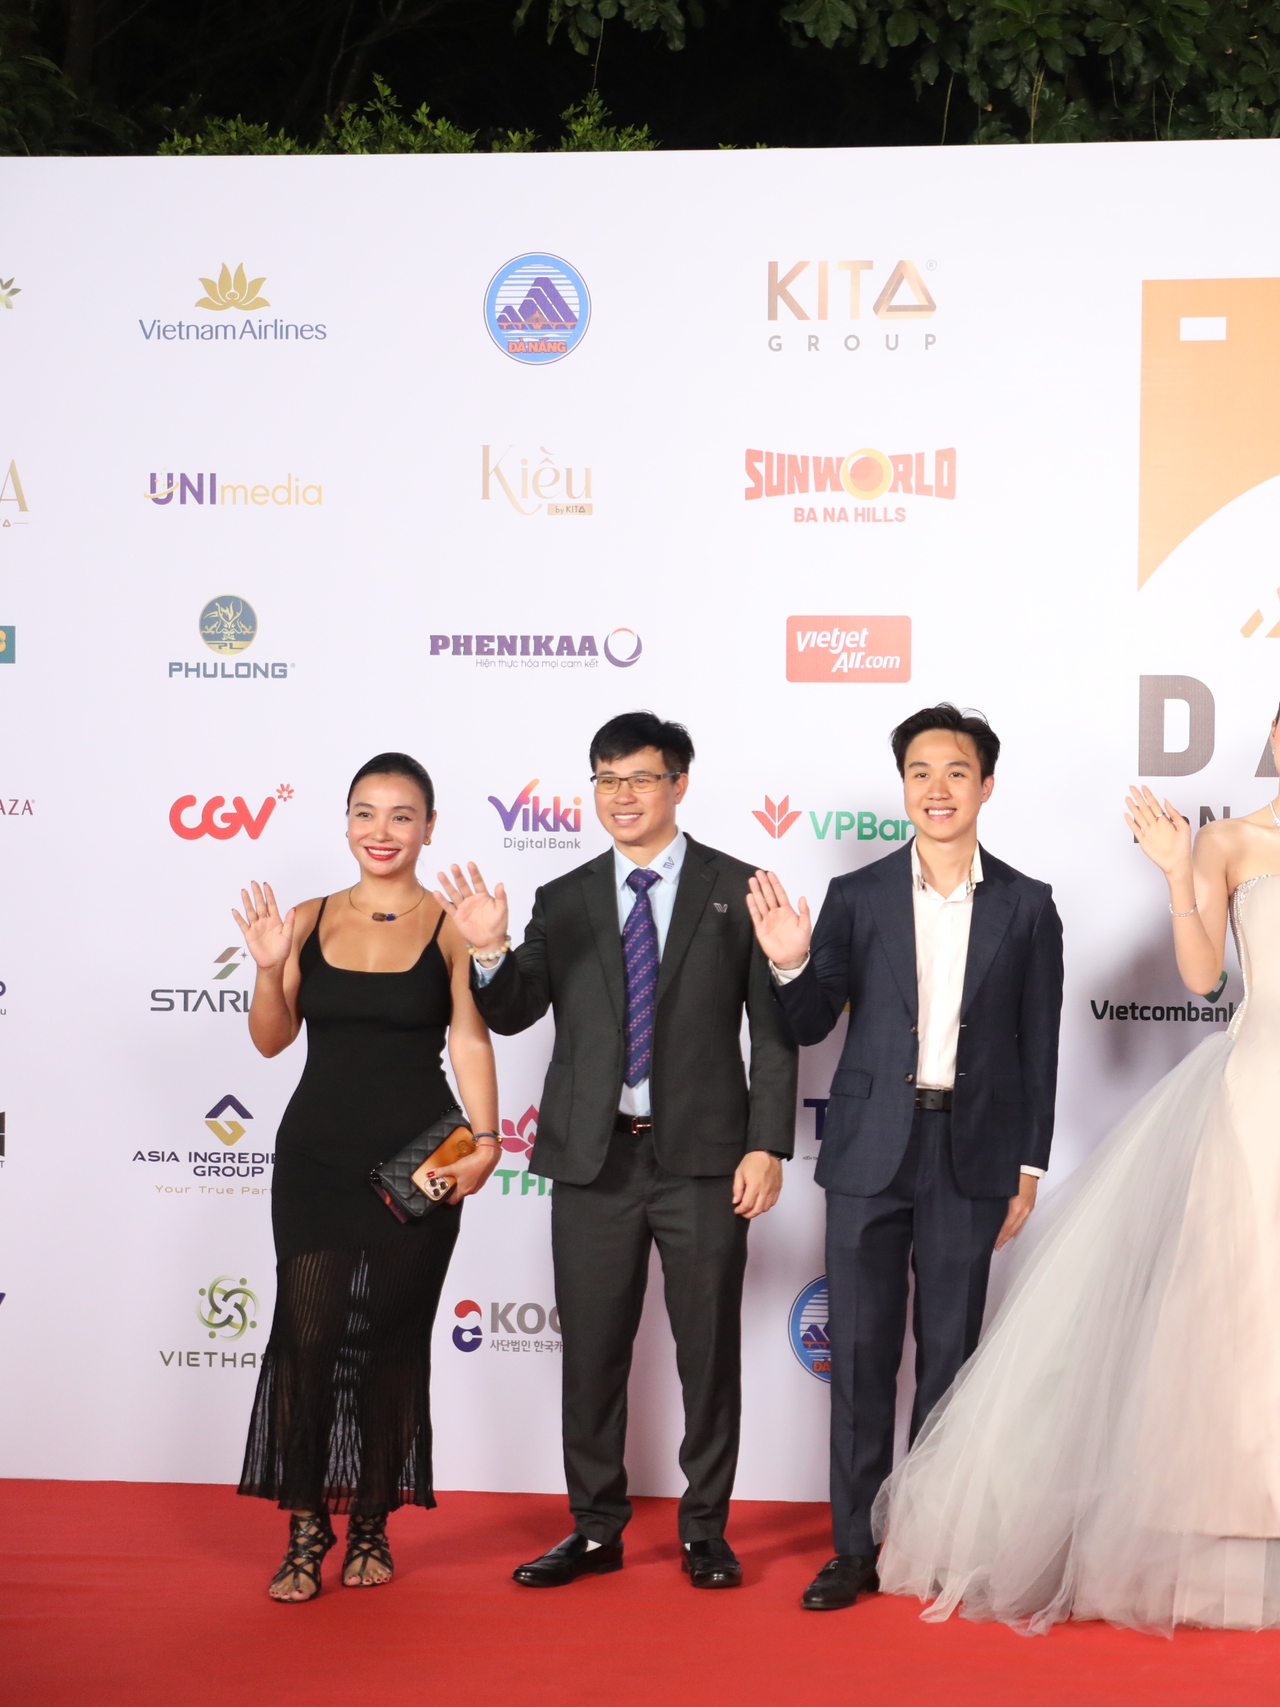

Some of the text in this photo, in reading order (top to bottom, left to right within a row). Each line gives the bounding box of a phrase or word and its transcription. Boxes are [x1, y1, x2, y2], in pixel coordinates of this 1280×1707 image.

[138, 319, 327, 340] Vietnam Airlines
[768, 333, 936, 352] GROUP
[481, 444, 592, 515] Kiều
[144, 472, 322, 506] UNImedia
[555, 505, 564, 514] by
[794, 507, 906, 523] BA NA HILLS
[429, 634, 599, 656] PHENIKAA
[168, 661, 288, 679] PHULONG
[476, 658, 496, 668] Hiện
[521, 658, 539, 668] hóa
[542, 660, 559, 669] mọi
[561, 660, 582, 668] cam
[584, 659, 599, 668] kết
[488, 778, 582, 832] Vikki
[169, 794, 277, 841] CGV
[504, 837, 581, 851] Digital Bank
[133, 1151, 180, 1162] ASIA
[193, 1165, 264, 1178] GROUP
[155, 1184, 191, 1194] Your
[199, 1185, 234, 1195] True
[490, 1340, 531, 1353] 사단법인
